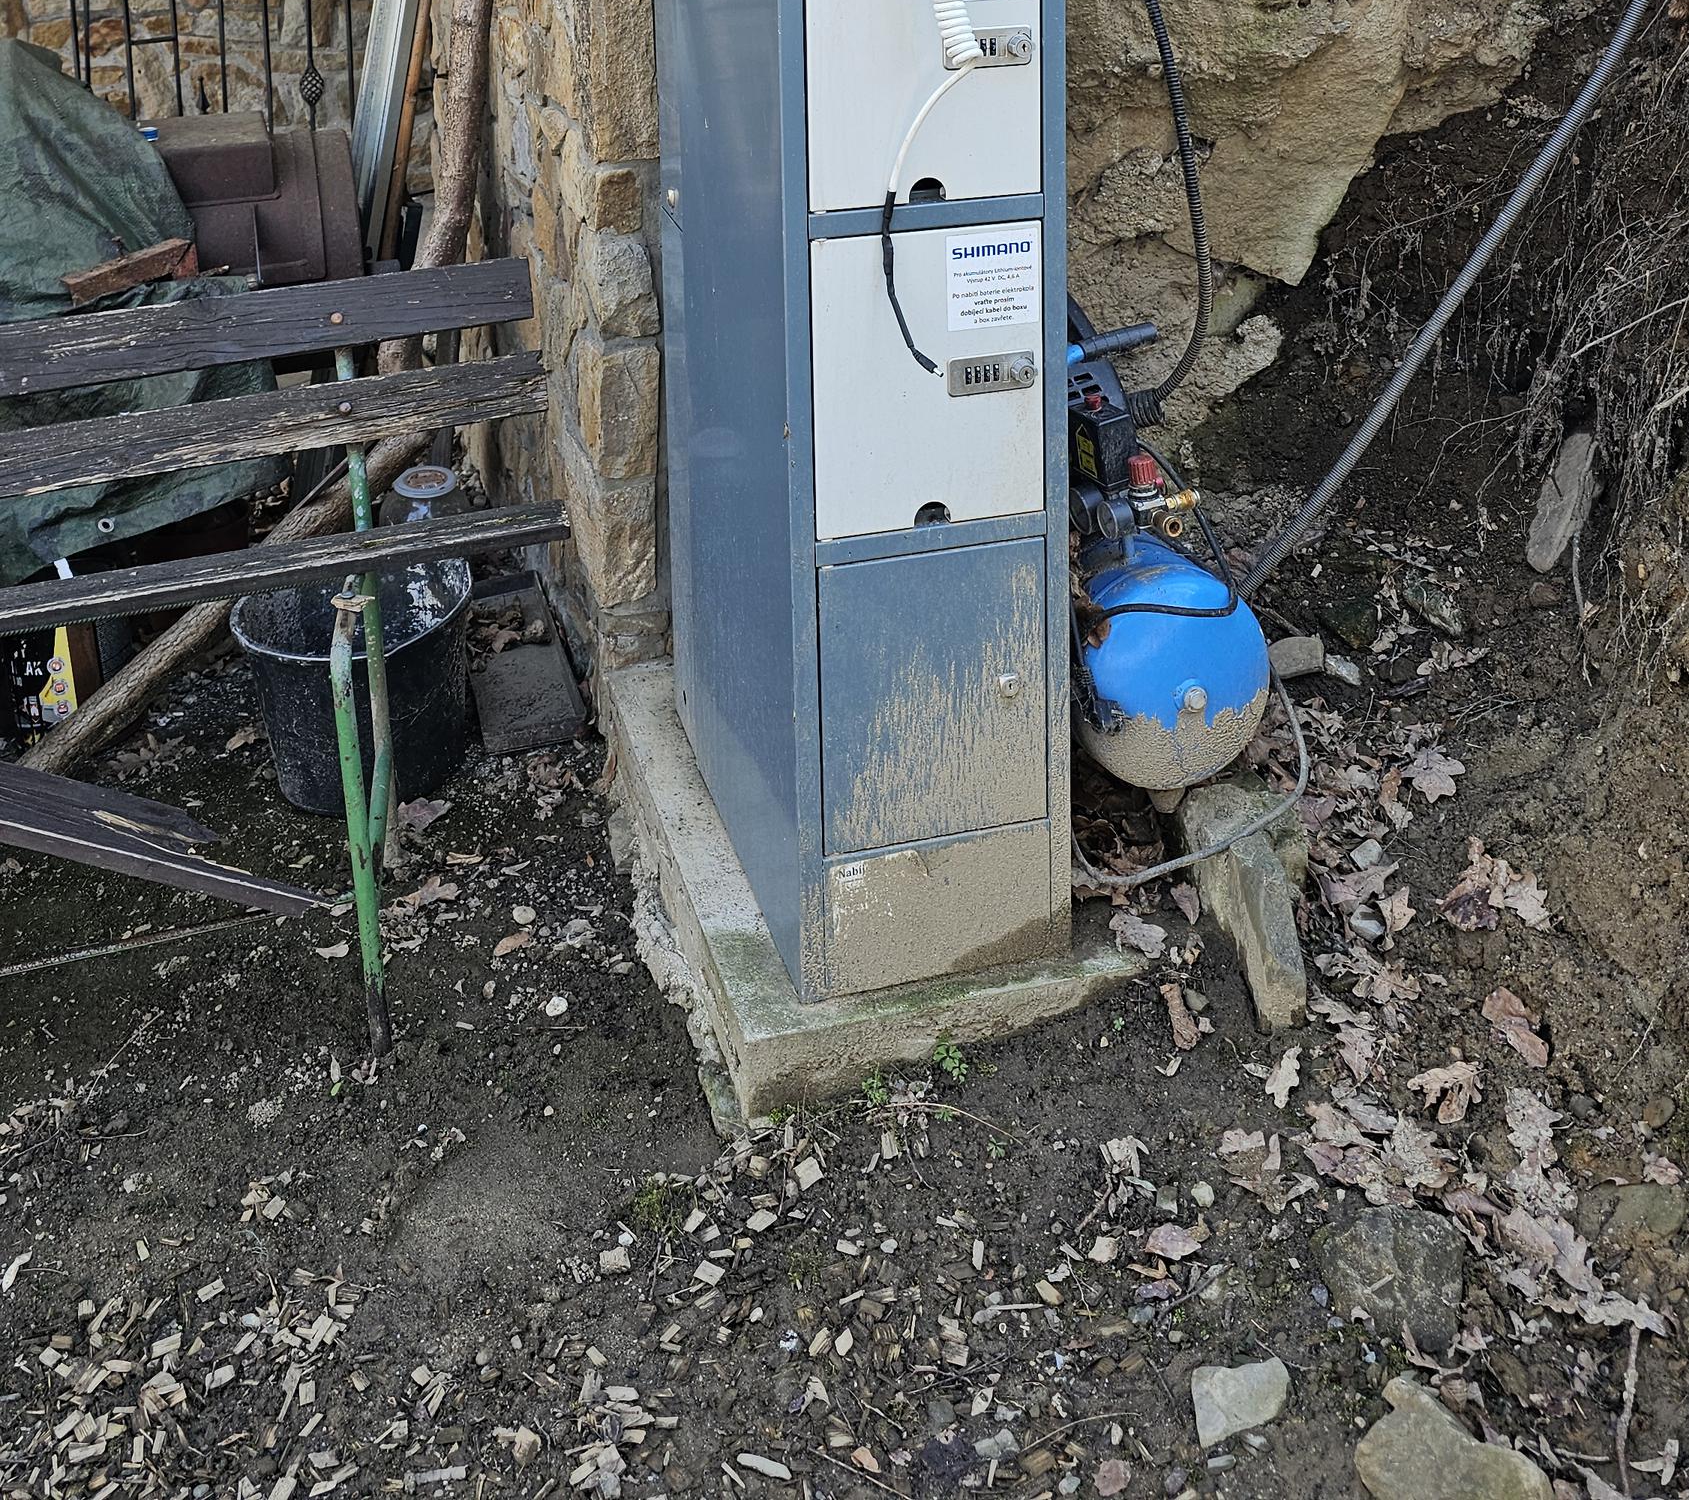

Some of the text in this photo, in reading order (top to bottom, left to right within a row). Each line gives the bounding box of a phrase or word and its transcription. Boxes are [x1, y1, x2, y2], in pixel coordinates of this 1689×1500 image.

[952, 241, 1030, 260] SHIMANO
[1002, 286, 1034, 294] elektrokola
[994, 296, 1014, 305] prosím
